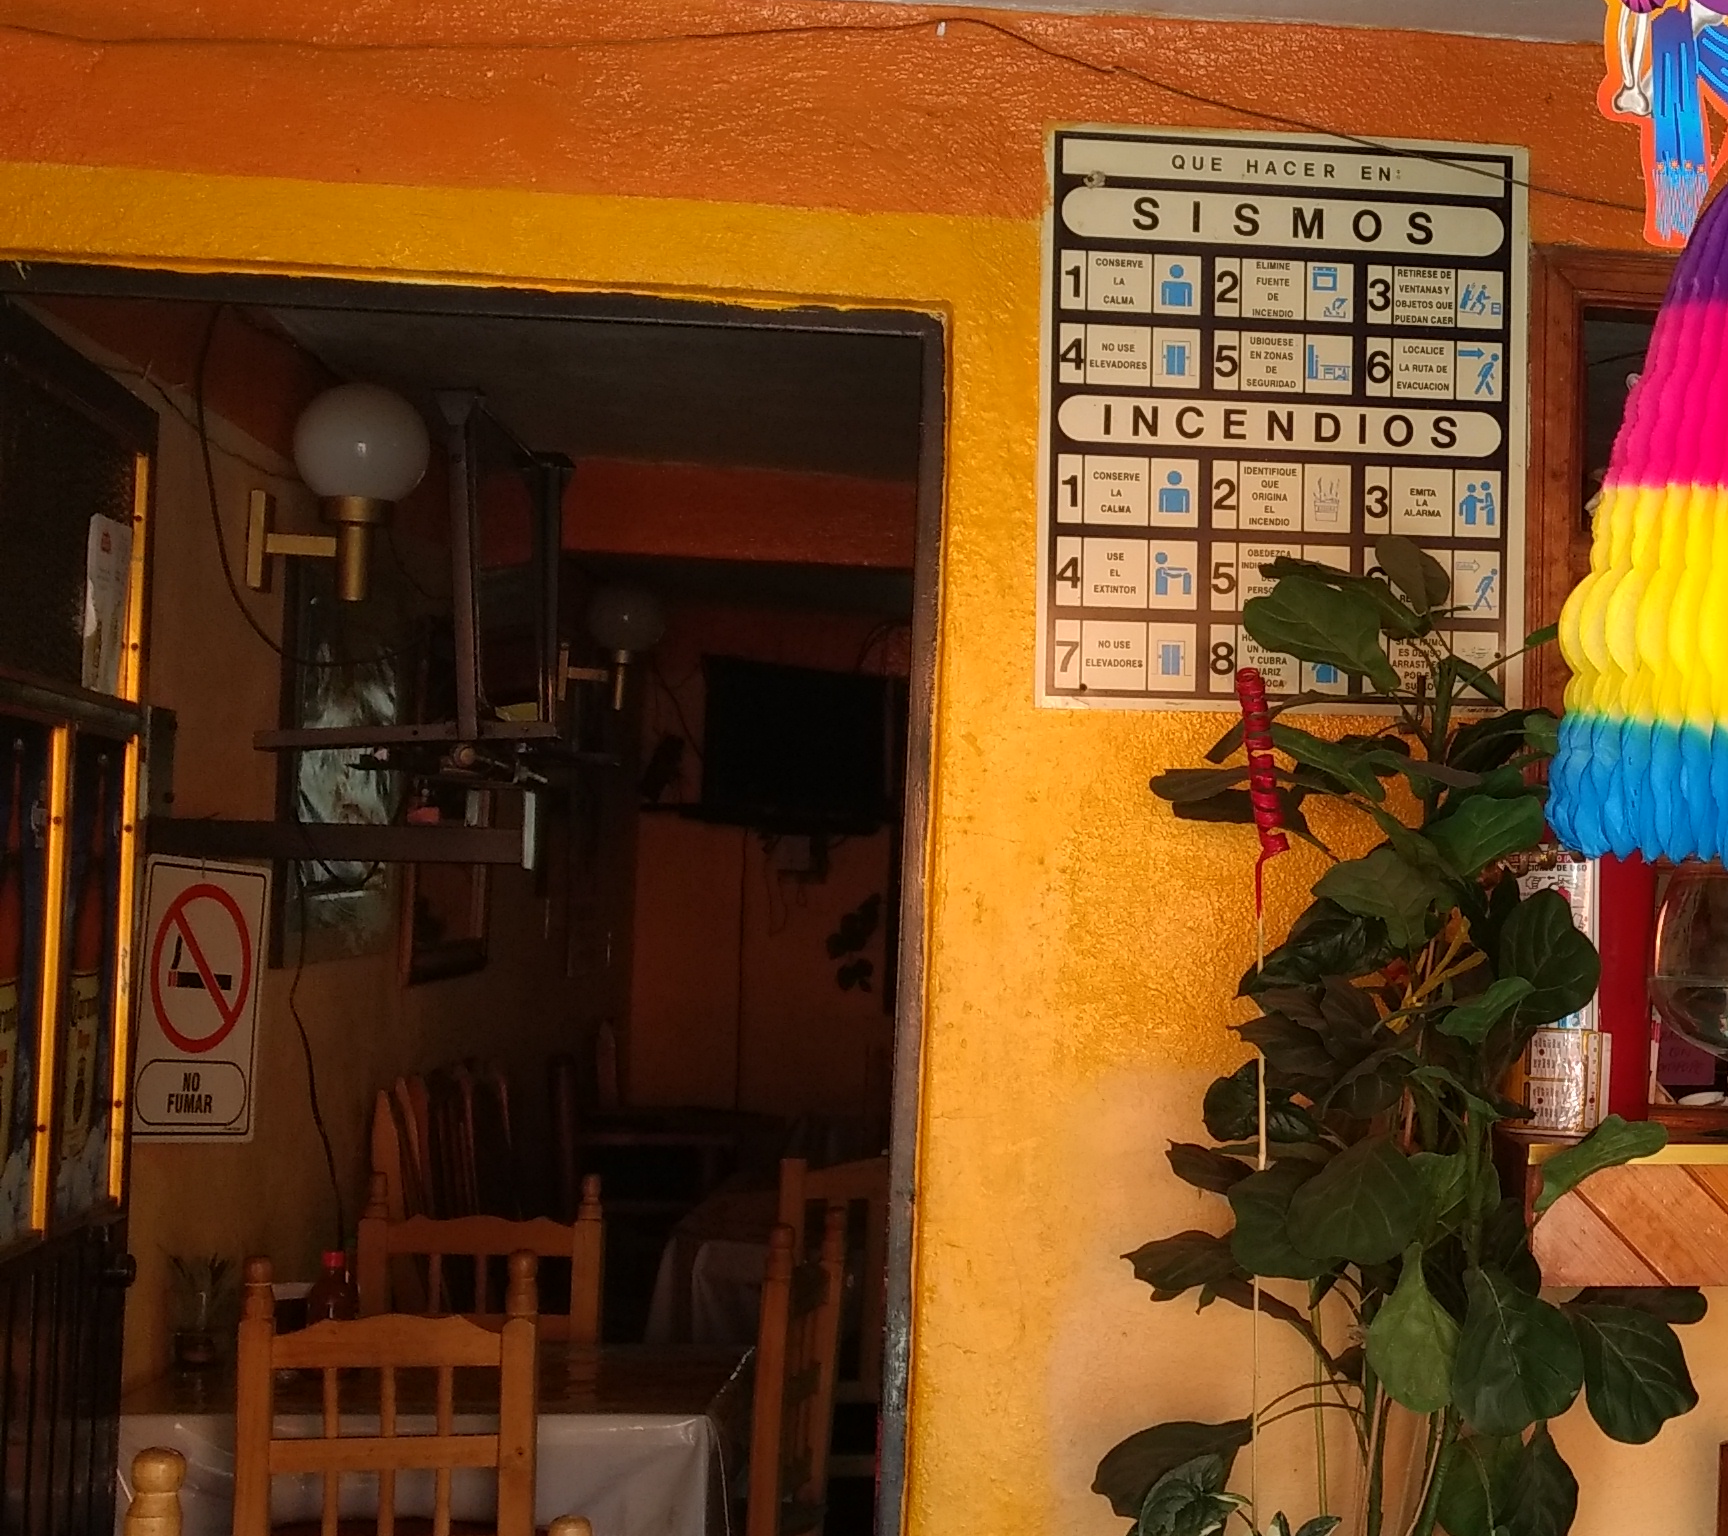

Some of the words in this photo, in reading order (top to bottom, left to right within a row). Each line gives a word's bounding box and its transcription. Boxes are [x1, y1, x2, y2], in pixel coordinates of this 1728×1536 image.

[1171, 155, 1222, 172] QUE
[1246, 159, 1336, 179] HACER
[1132, 196, 1434, 245] SISMOS
[1095, 258, 1144, 269] CONSERVE
[1256, 261, 1291, 271] ELIMINE
[1397, 269, 1438, 279] RETIRESE
[1440, 270, 1452, 279] DE
[1065, 265, 1081, 298] 1
[1113, 277, 1125, 286] LA
[1216, 270, 1239, 304] 2
[1256, 277, 1290, 287] FUENTE
[1369, 278, 1390, 311] 3
[1399, 285, 1443, 294] VENTANAS
[1444, 286, 1450, 294] Y
[1103, 295, 1135, 306] CALMA
[1267, 292, 1279, 302] DE
[1395, 300, 1434, 309] OBJETOS
[1436, 300, 1453, 310] QUE
[1251, 308, 1294, 319] INCENDIO
[1395, 315, 1429, 324] PUEDAN
[1430, 315, 1454, 325] CAER
[1101, 342, 1115, 352] NO
[1117, 343, 1136, 353] USE
[1249, 337, 1294, 348] UBIQUESE
[1060, 338, 1084, 371] 4
[1402, 345, 1444, 355] LOCALICE
[1215, 345, 1238, 378] 5
[1250, 351, 1262, 360] EN
[1264, 351, 1294, 361] ZONAS
[1089, 359, 1147, 370] ELEVADORES
[1265, 365, 1277, 374] DE
[1367, 350, 1391, 383] 6
[1399, 364, 1410, 372] LA
[1412, 364, 1434, 373] RUTA
[1436, 365, 1448, 373] DE
[1246, 378, 1296, 389] SEGURIDAD
[1396, 381, 1450, 391] EVACUACION
[1103, 404, 1458, 449] INCENDIOS
[1093, 471, 1140, 483] CONSERVE
[1243, 466, 1297, 477] IDENTIFIQUE
[1260, 479, 1279, 490] QUE
[1061, 475, 1078, 507] 1
[1110, 488, 1122, 498] LA
[1213, 479, 1236, 511] 2
[1409, 488, 1437, 497] EMITA
[1251, 492, 1288, 502] ORIGINA
[1365, 485, 1388, 518] 3
[1415, 499, 1428, 507] LA
[1100, 504, 1132, 514] CALMA
[1264, 505, 1275, 514] EL
[1403, 508, 1441, 518] ALARMA
[1248, 517, 1290, 527] INCENDIO
[1106, 551, 1125, 562] USE
[1247, 549, 1291, 558] OBEDEZCA
[1056, 555, 1080, 588] 4
[1109, 568, 1121, 578] EL
[1211, 560, 1235, 594] 5
[1093, 584, 1137, 596] EXTINTOR
[1247, 586, 1274, 594] PERSO
[1098, 639, 1110, 649] NO
[1113, 640, 1131, 650] USE
[1247, 645, 1259, 653] UN
[1056, 642, 1078, 672] 7
[1398, 649, 1409, 657] ES
[1085, 658, 1143, 669] ELEVADORES
[1211, 645, 1234, 676] 8
[1249, 656, 1255, 664] Y
[1257, 656, 1287, 665] CUBRA
[1266, 678, 1284, 688] OCA
[183, 1073, 200, 1092] NO
[167, 1094, 212, 1113] FUMAR
